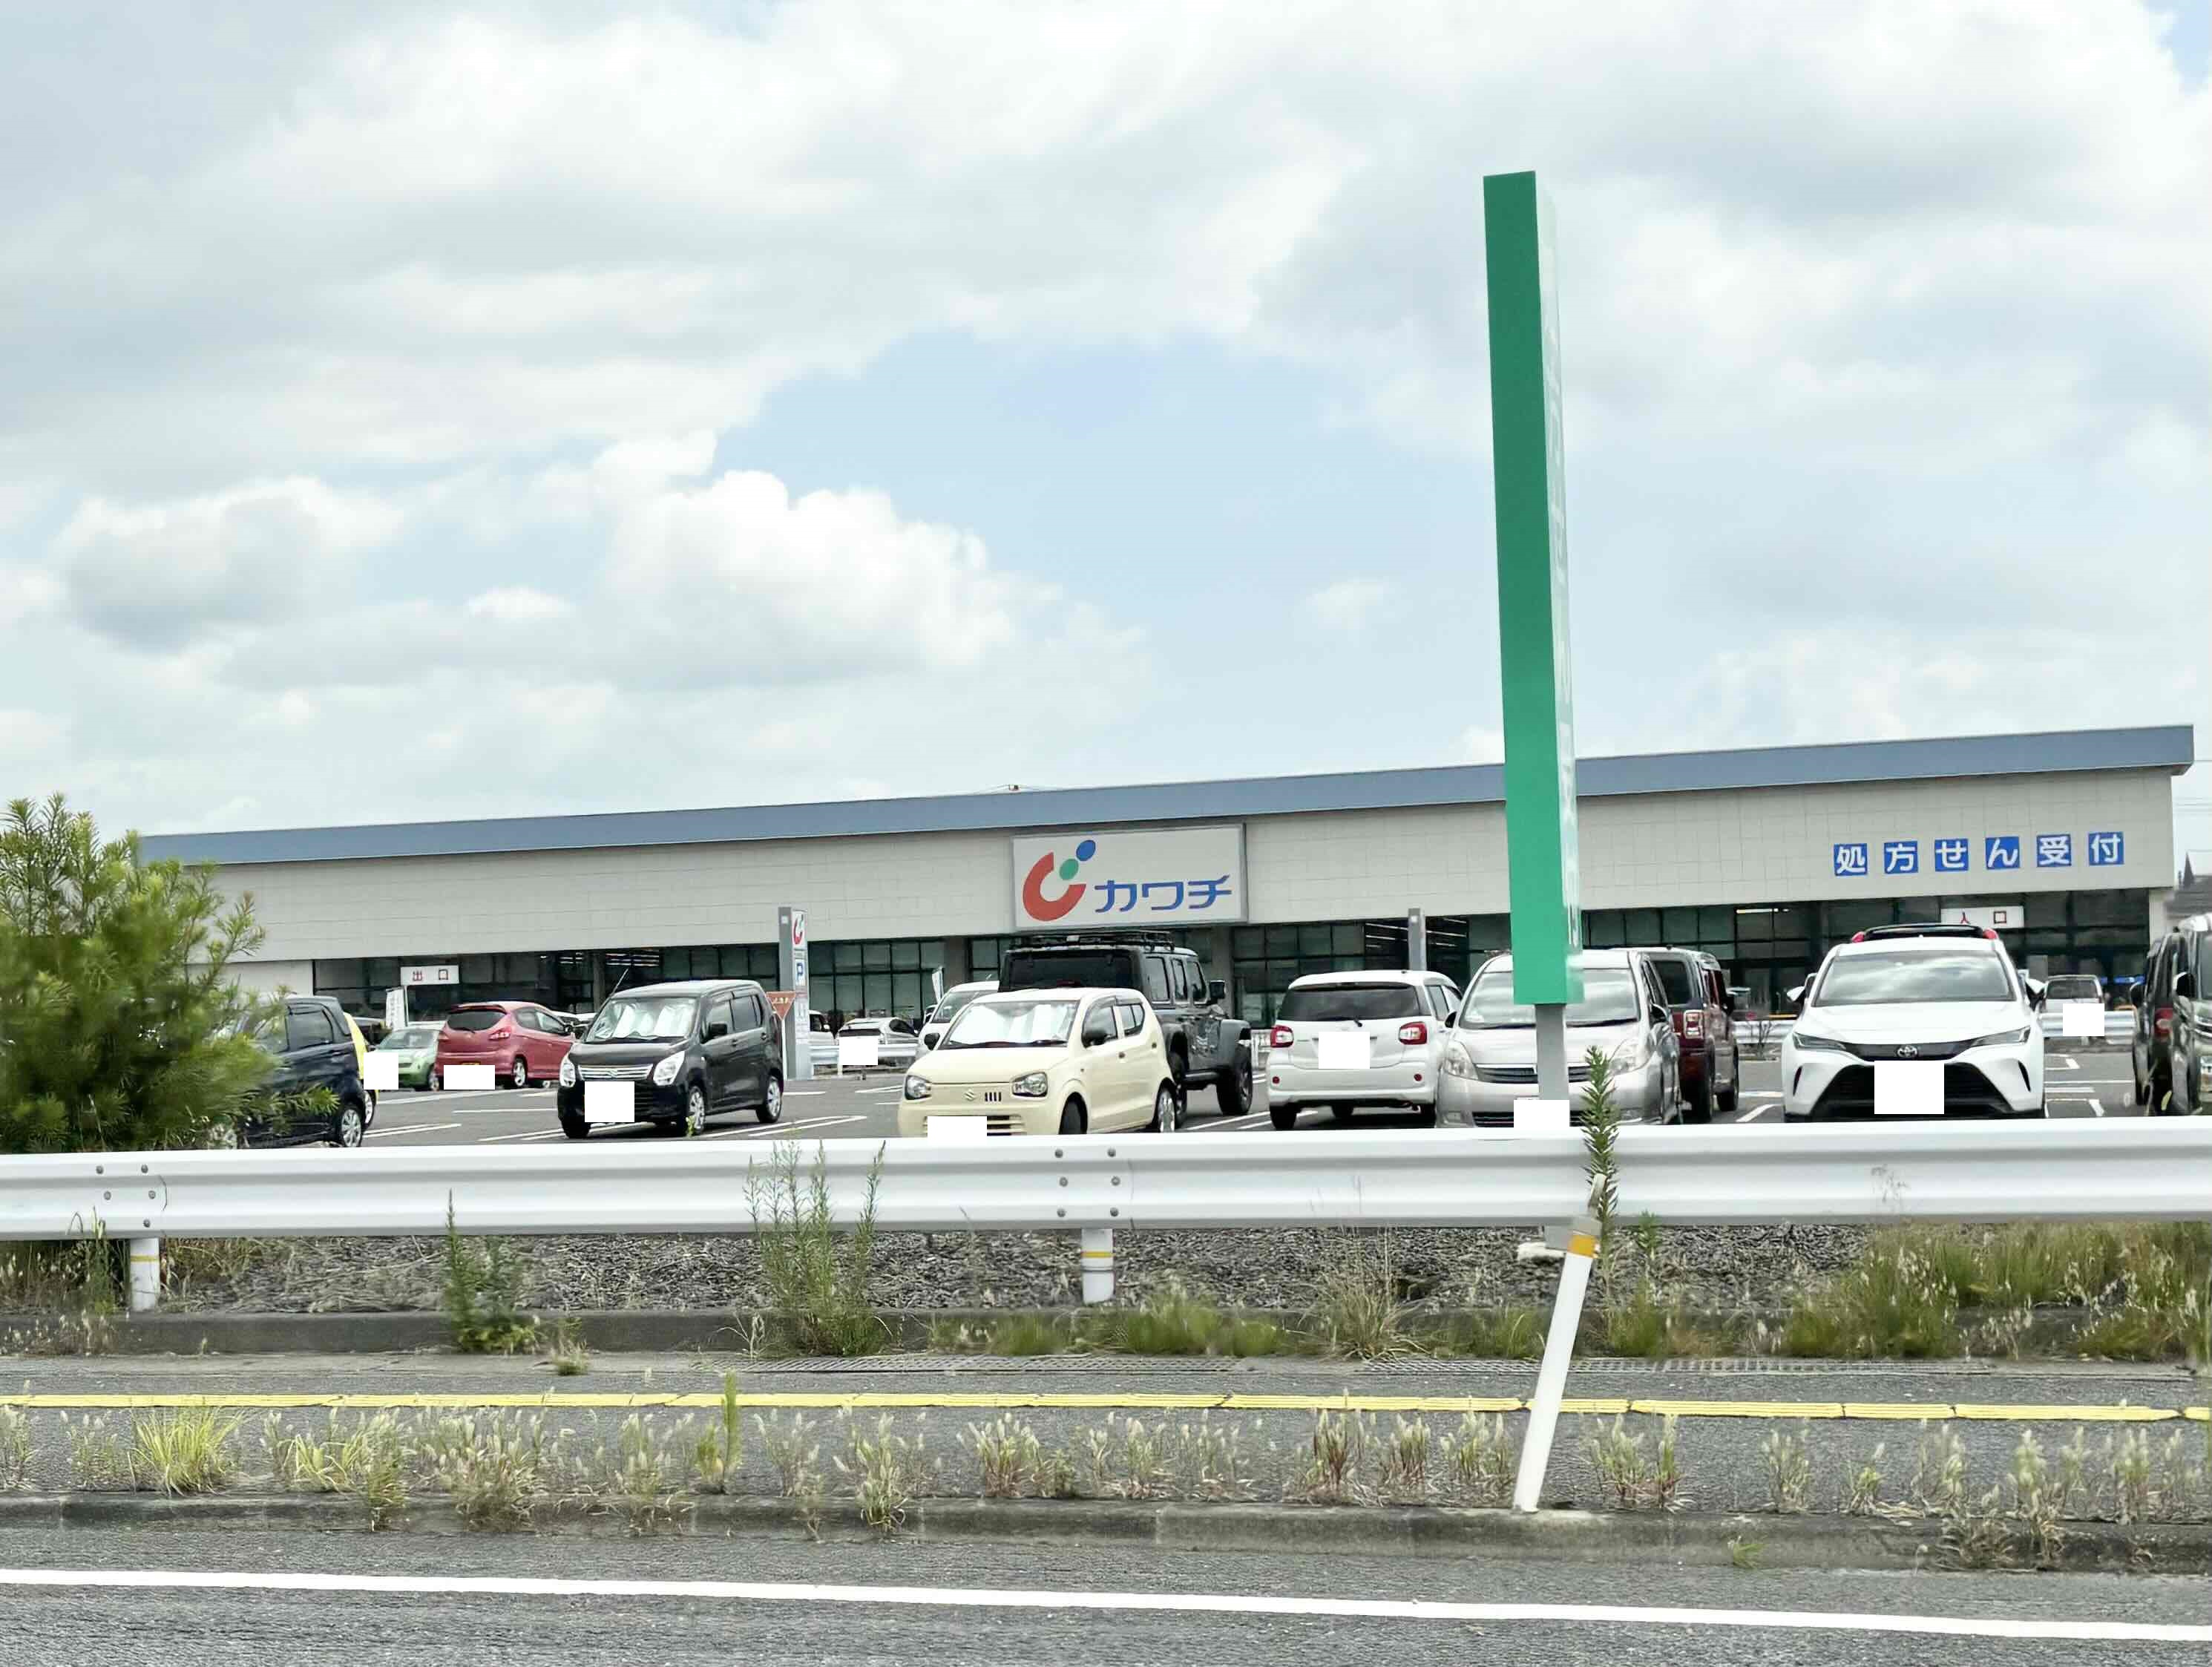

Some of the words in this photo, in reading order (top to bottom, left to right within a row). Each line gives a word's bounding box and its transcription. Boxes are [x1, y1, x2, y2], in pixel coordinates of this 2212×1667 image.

[1835, 833, 2123, 874] 処方せん受付
[1094, 875, 1232, 913] カワチ
[413, 969, 449, 981] 出口
